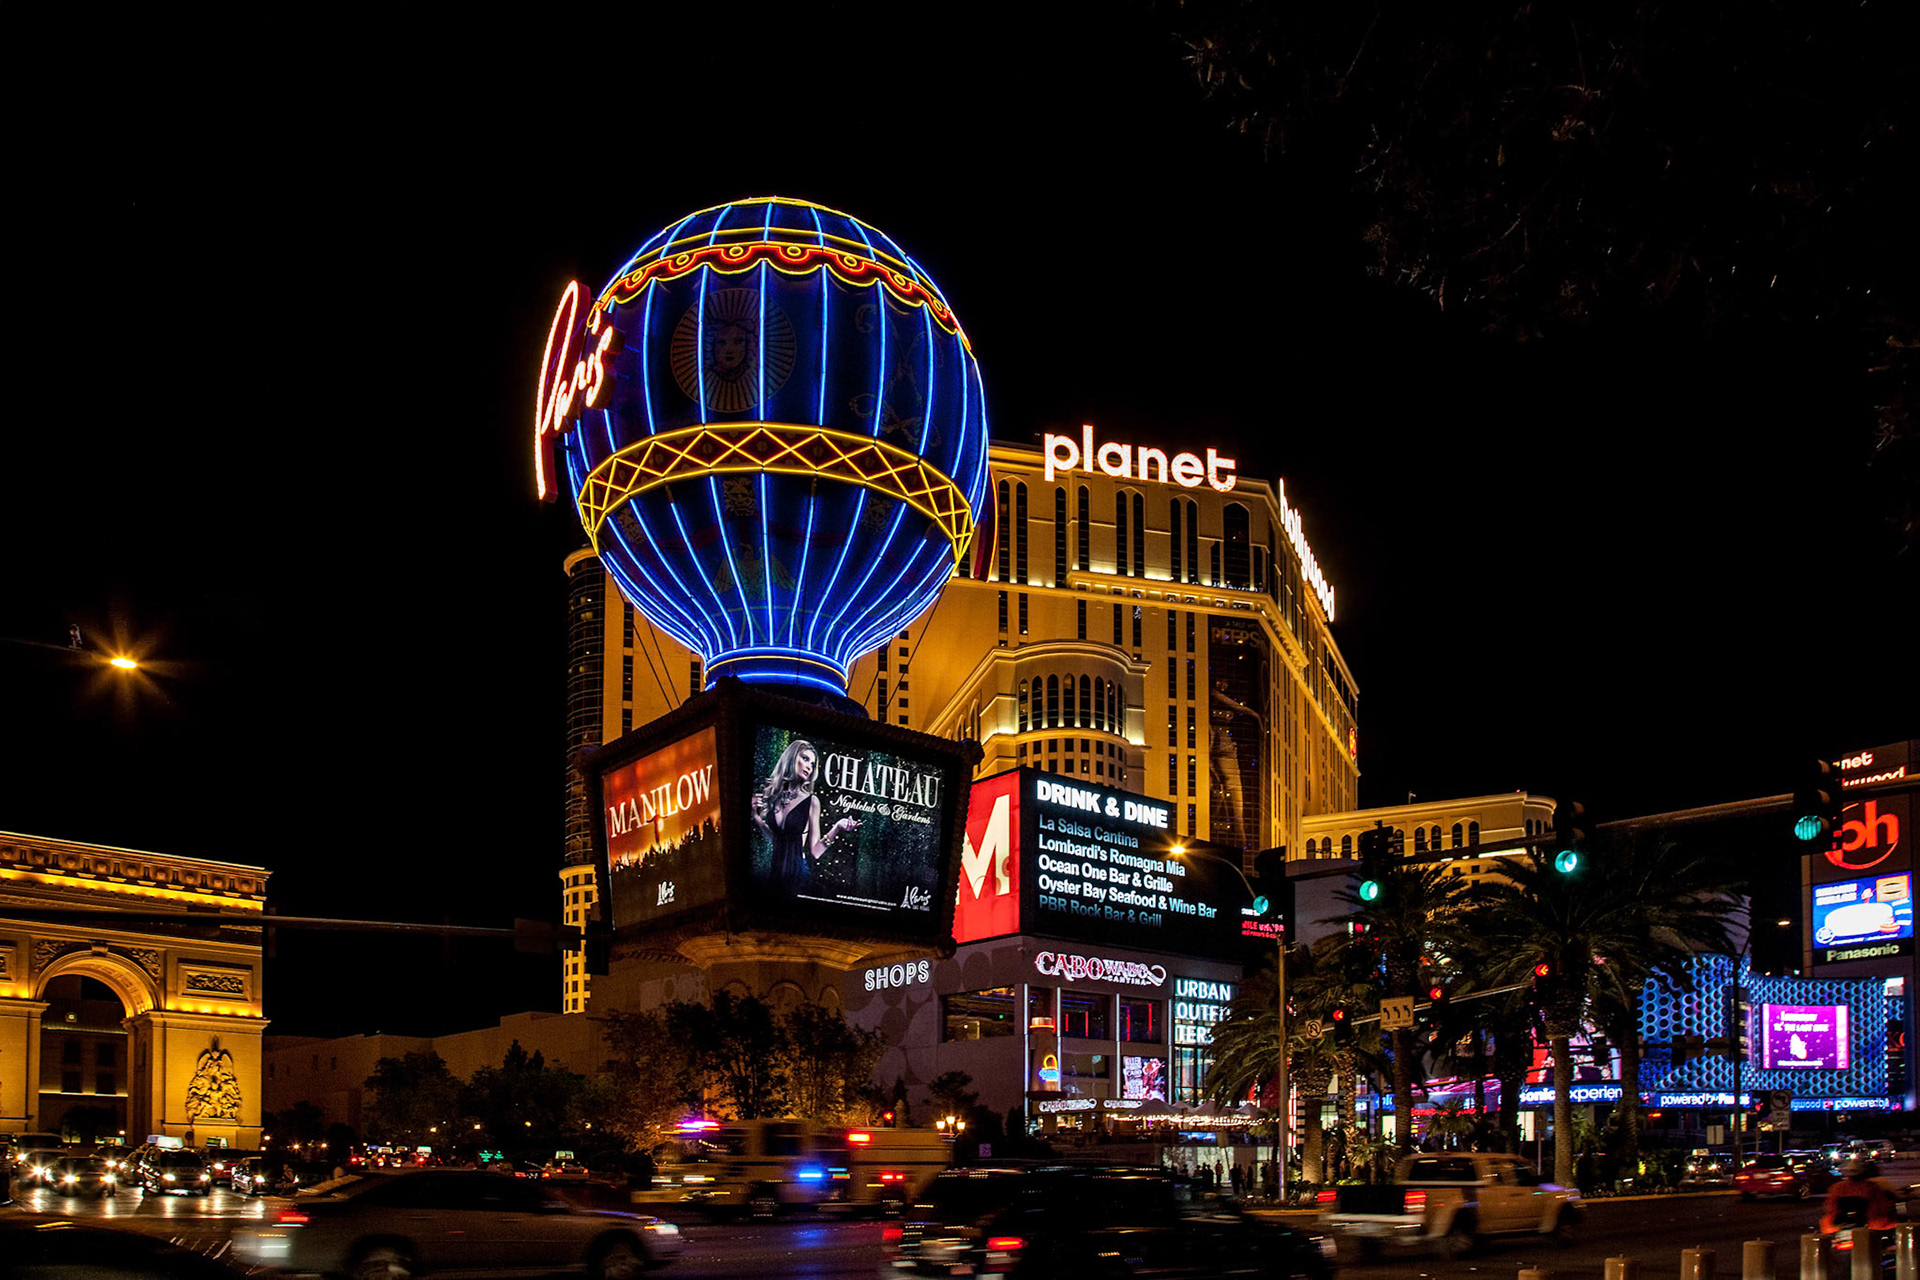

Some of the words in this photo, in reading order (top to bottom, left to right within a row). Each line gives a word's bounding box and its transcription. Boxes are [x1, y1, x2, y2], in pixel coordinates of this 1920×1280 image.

[535, 280, 613, 500] Paris
[1044, 425, 1237, 492] planet
[824, 752, 941, 808] CHATEAU
[609, 765, 713, 838] MANILOW
[830, 794, 876, 813] Nightclub
[877, 803, 891, 816] &
[891, 804, 931, 824] Gardens
[1037, 780, 1101, 813] DRINK
[1104, 797, 1120, 818] &
[1124, 800, 1168, 828] DINE
[1039, 814, 1055, 831] La
[1058, 817, 1091, 838] Salsa
[1094, 826, 1138, 848] Cantina
[955, 794, 1010, 905] M
[1039, 834, 1107, 861] Lombardi's
[1110, 848, 1164, 874] Romagna
[1166, 860, 1186, 876] Mia
[1039, 854, 1079, 876] Ocean
[1082, 862, 1107, 881] One
[1109, 867, 1130, 885] Bar
[1132, 871, 1141, 887] &
[1144, 874, 1173, 893] Grille
[910, 886, 931, 905] Paris
[1039, 874, 1081, 894] Oyster
[1083, 881, 1107, 902] Bay
[1109, 887, 1156, 908] Seafood
[1158, 897, 1167, 910] &
[1169, 897, 1196, 914] Wine
[1198, 903, 1217, 918] Bar
[1039, 895, 1067, 913] PBR
[1070, 900, 1101, 917] Rock
[1104, 905, 1125, 921] Bar
[1127, 909, 1136, 923] &
[1139, 911, 1162, 927] Grill
[1034, 951, 1105, 982] CABO
[1103, 959, 1149, 979] WABO
[1826, 943, 1900, 962] Panasonic
[865, 960, 929, 991] SHOPS
[1107, 975, 1147, 986] CANTINA
[1176, 979, 1231, 1001] URBAN
[1660, 1093, 1705, 1108] powered
